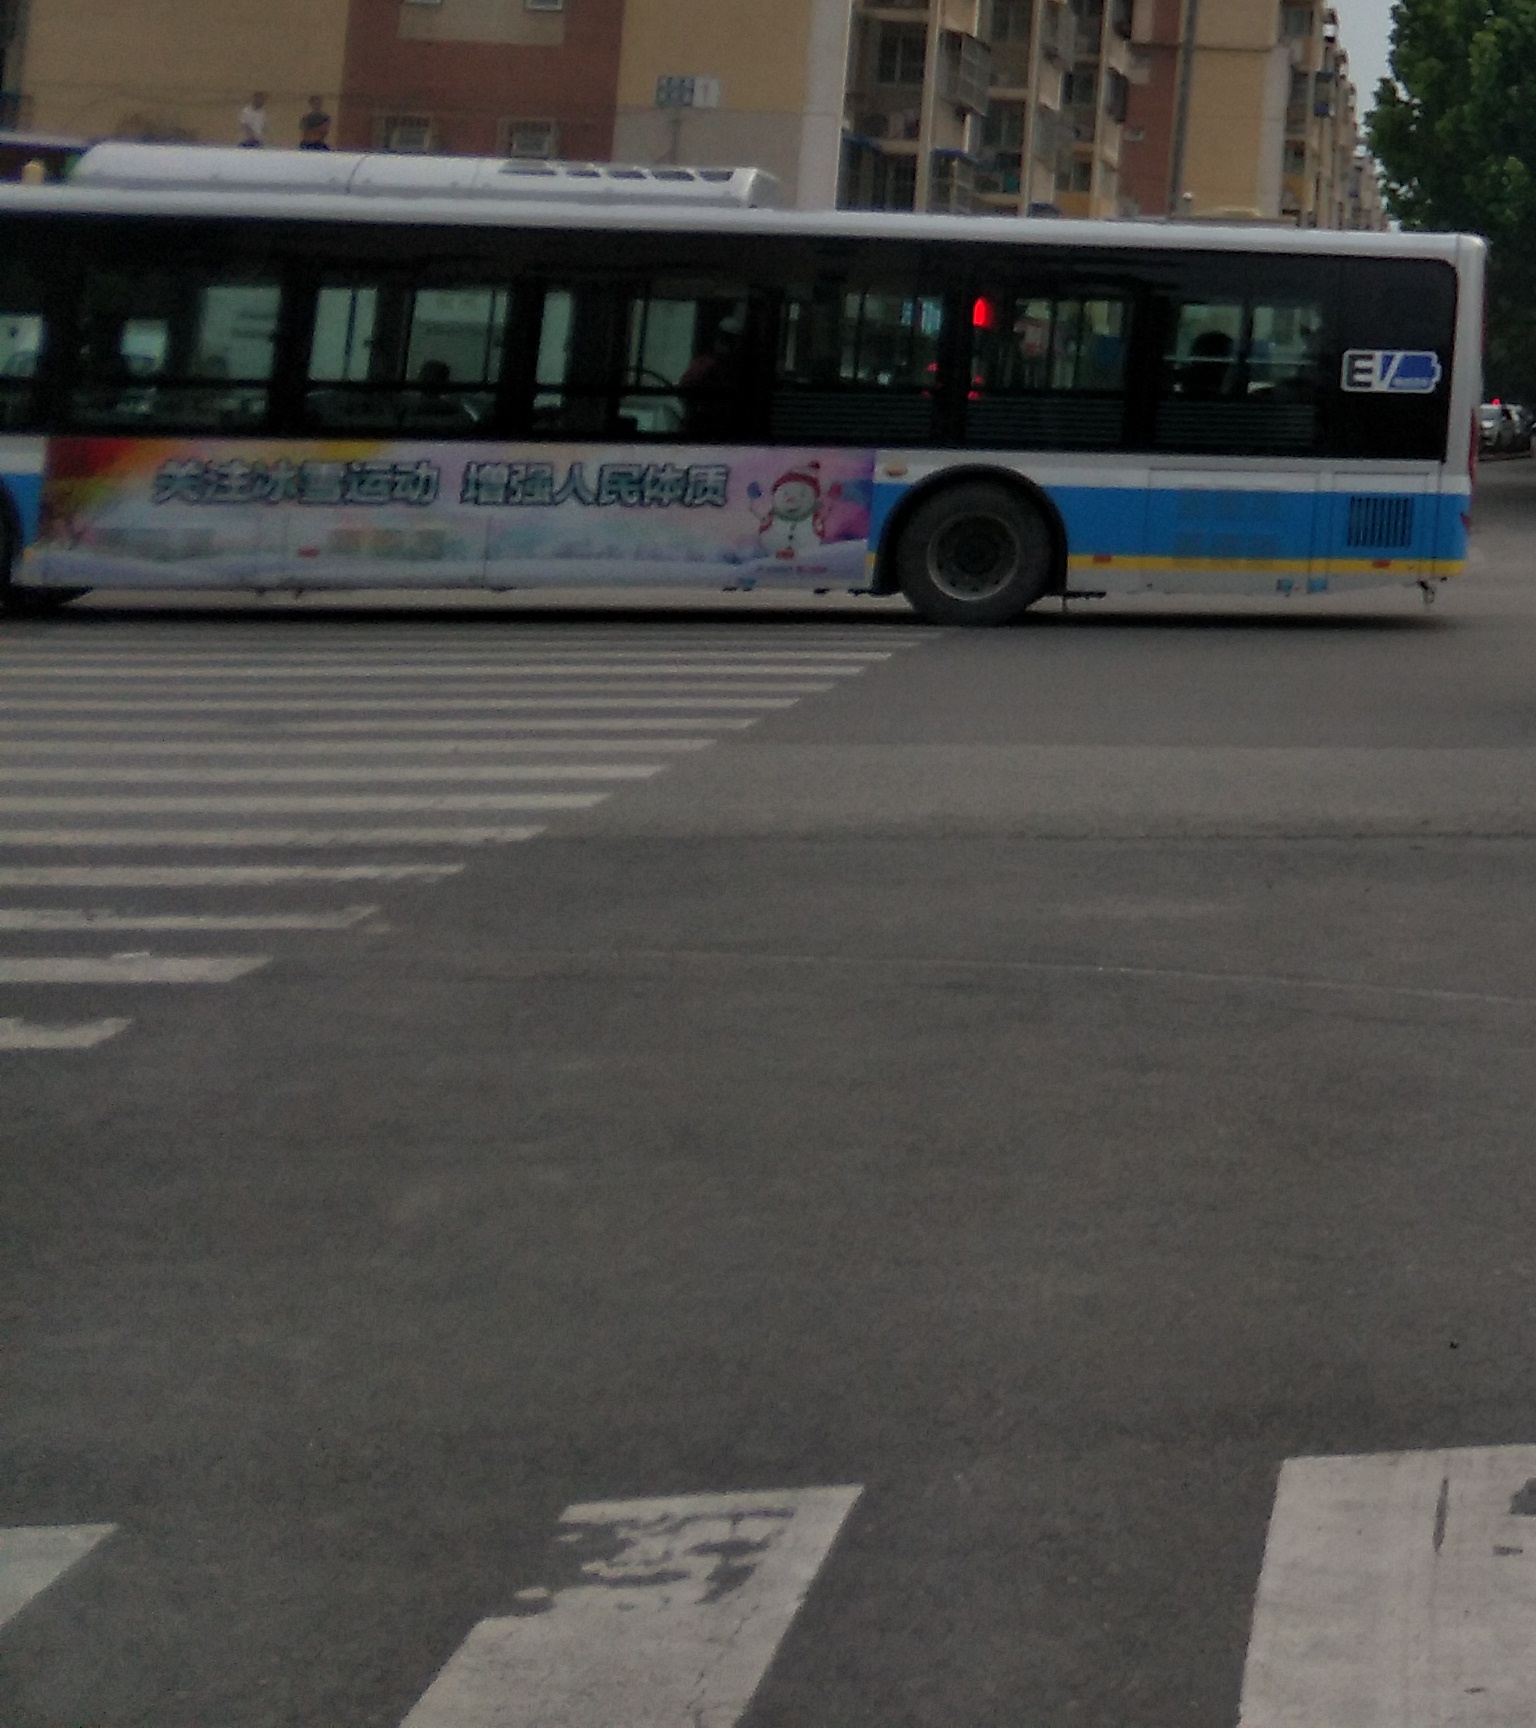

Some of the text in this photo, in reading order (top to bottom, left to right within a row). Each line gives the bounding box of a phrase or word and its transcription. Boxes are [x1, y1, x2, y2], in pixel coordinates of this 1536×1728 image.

[1345, 352, 1404, 391] EV
[152, 458, 731, 508] 关注冰雪运动 增强人民体质
